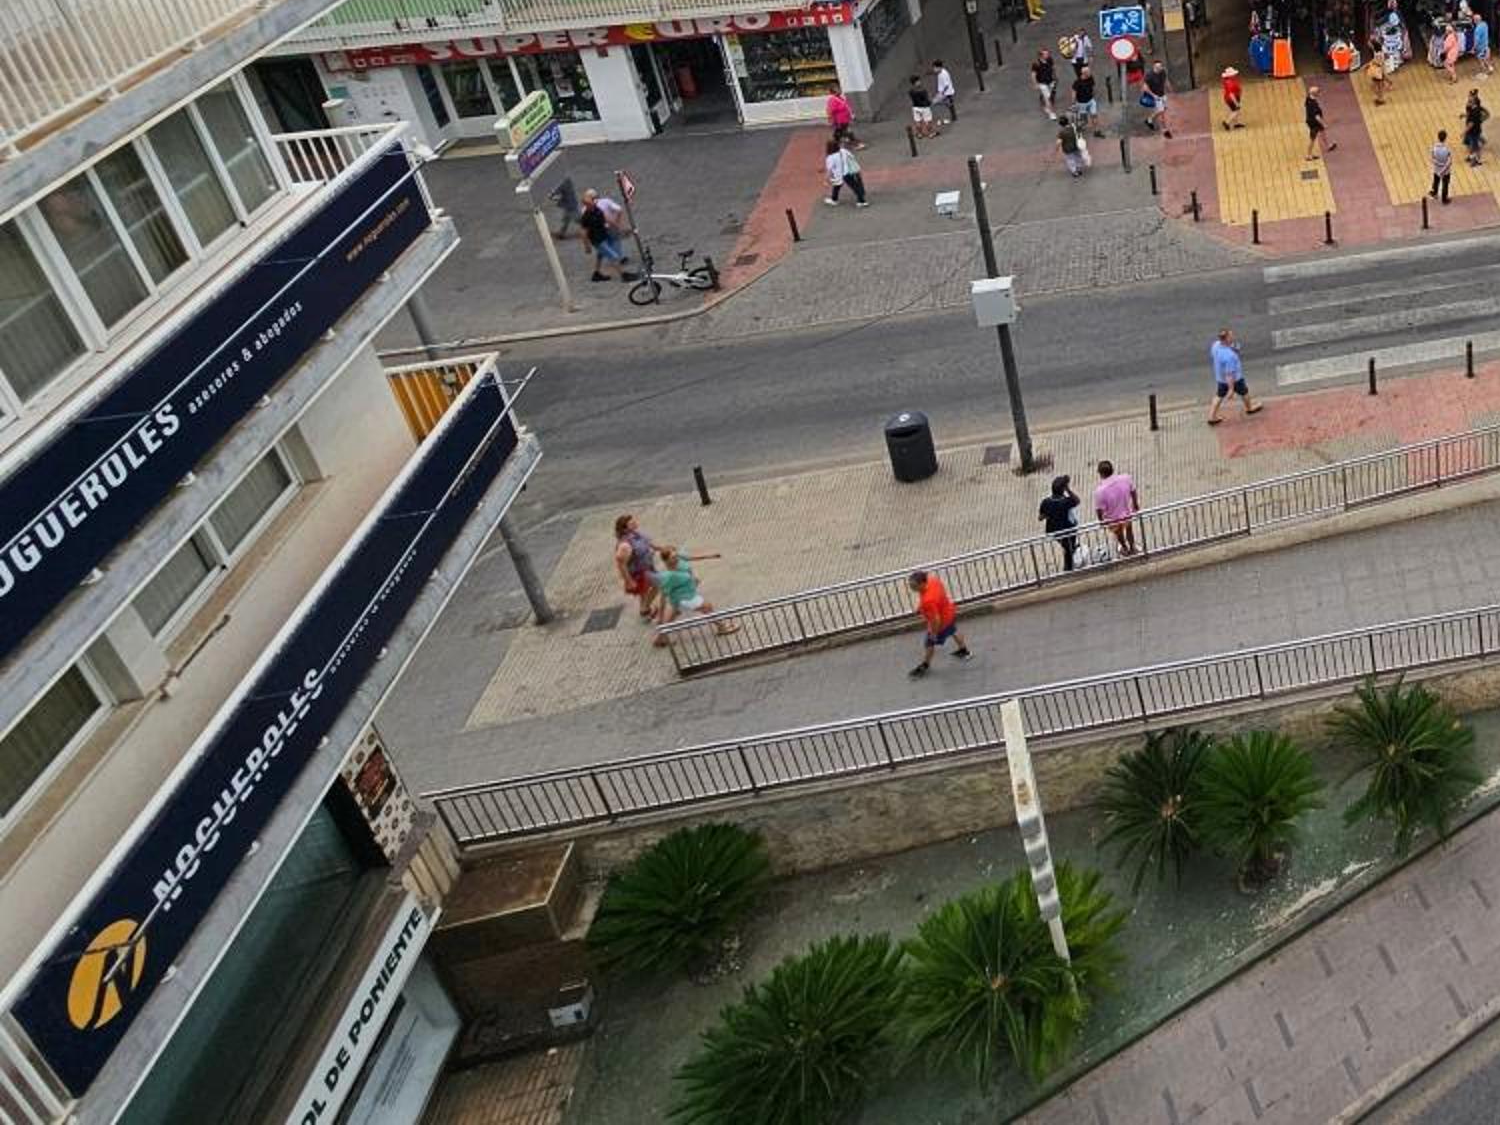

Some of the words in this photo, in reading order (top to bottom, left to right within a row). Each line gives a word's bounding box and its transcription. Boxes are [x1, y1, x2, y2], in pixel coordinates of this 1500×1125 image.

[421, 27, 610, 60] SUPER
[241, 346, 254, 362] &
[255, 300, 303, 351] abogados
[324, 1046, 351, 1093] DE
[349, 906, 423, 1046] PONIENTE
